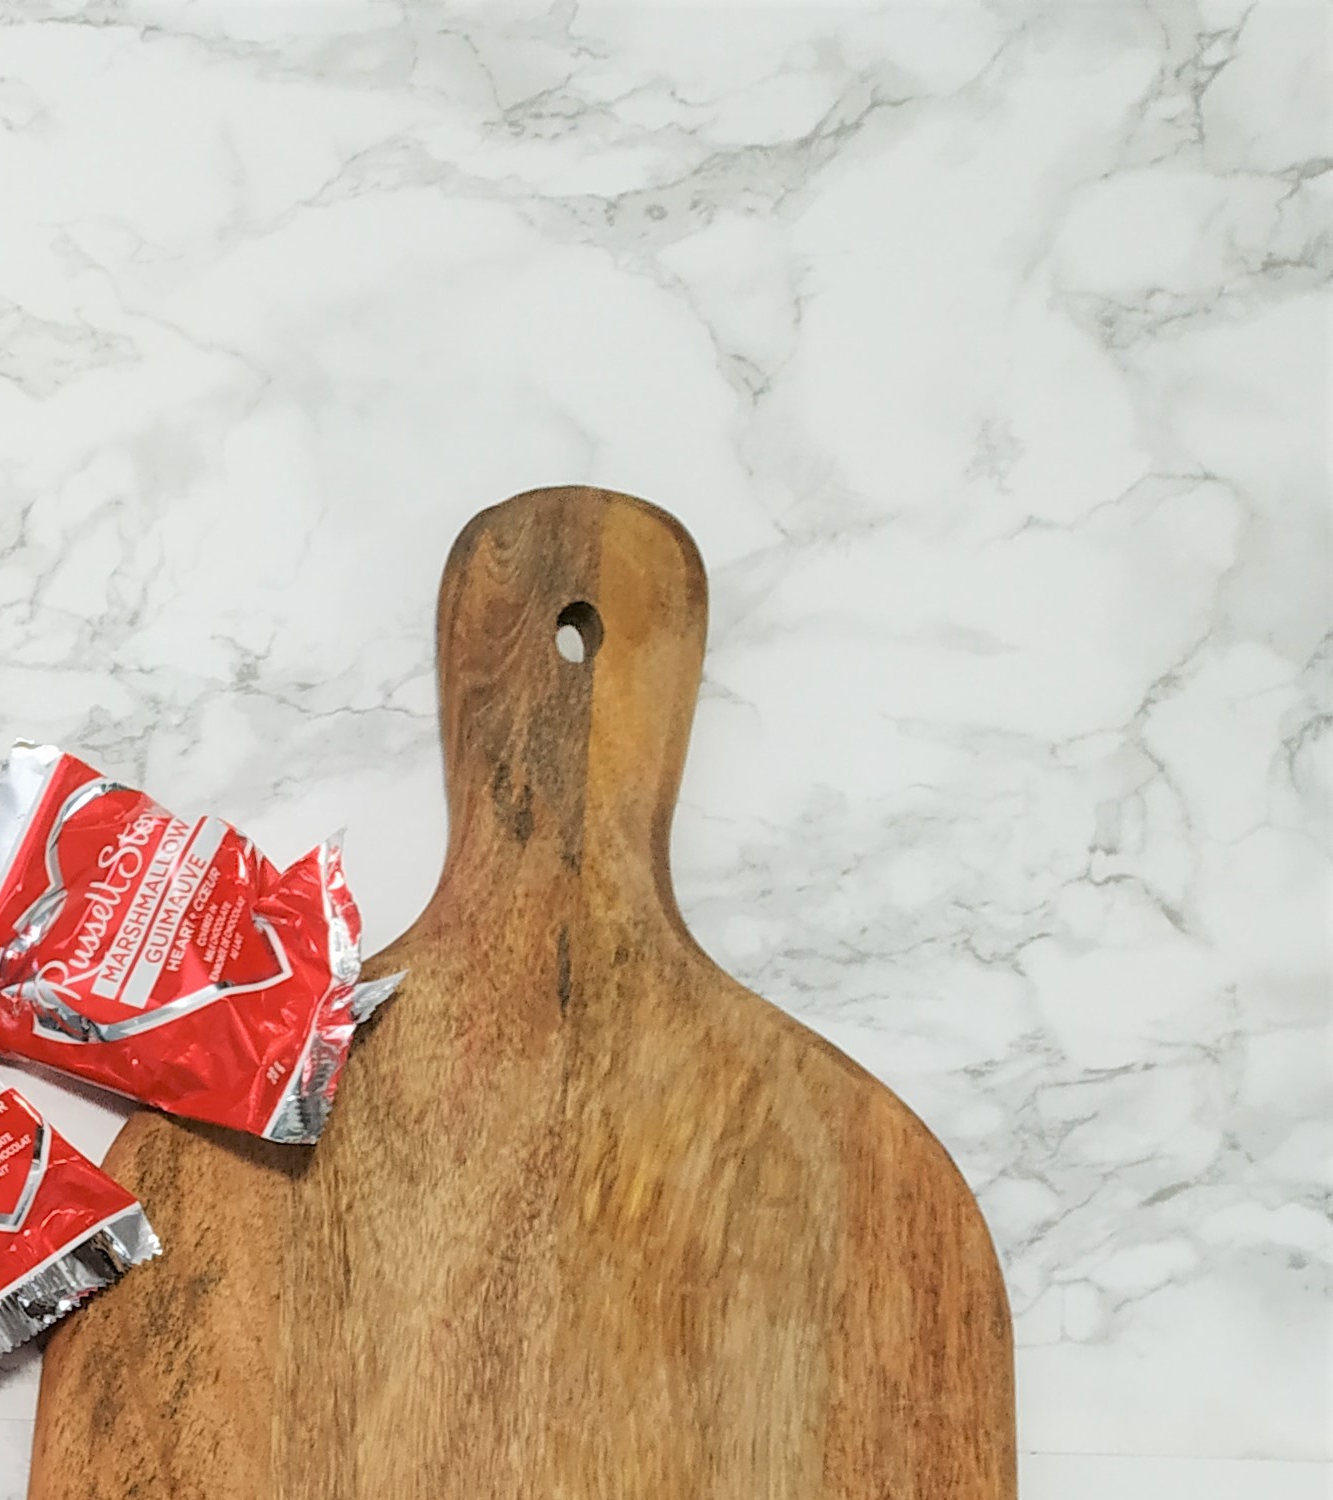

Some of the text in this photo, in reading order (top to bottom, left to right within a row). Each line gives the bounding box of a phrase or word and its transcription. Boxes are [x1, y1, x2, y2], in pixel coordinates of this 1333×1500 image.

[35, 879, 132, 1009] Russell
[100, 818, 190, 983] MARSHMALLOW
[144, 854, 208, 964] GUIMAUVE
[165, 921, 196, 972] HEART
